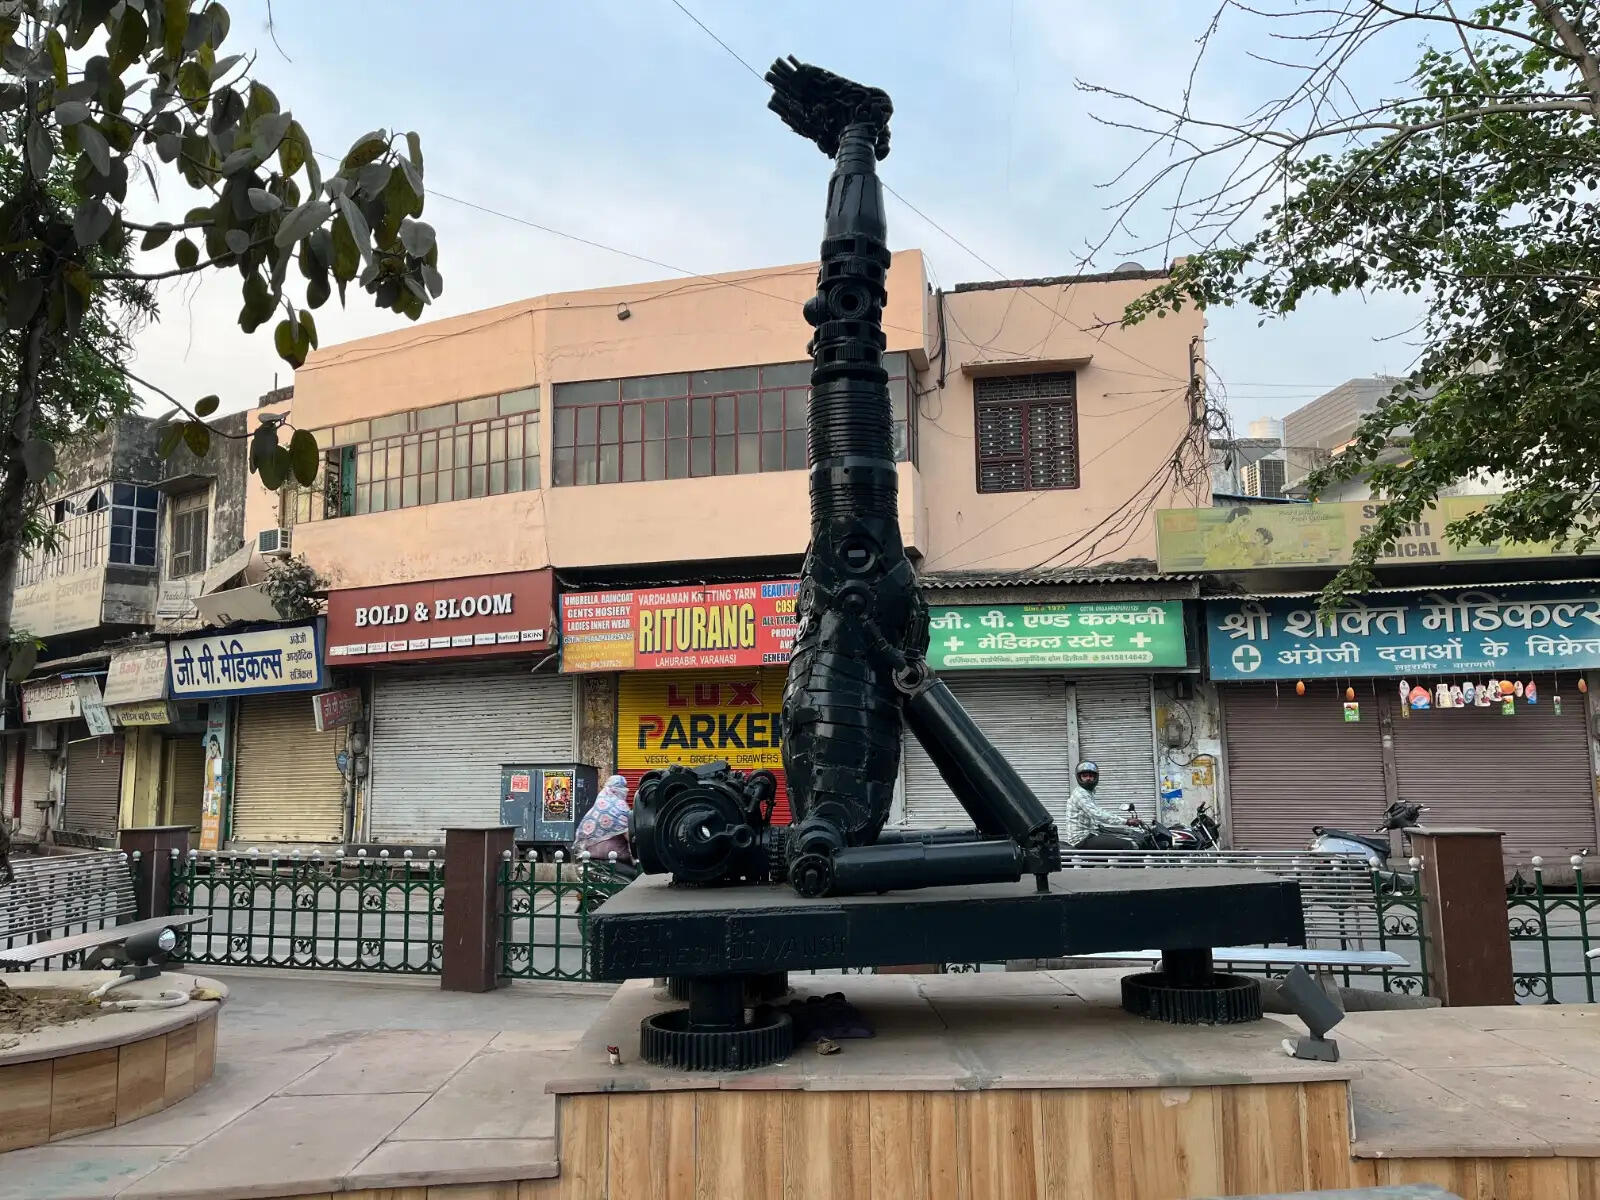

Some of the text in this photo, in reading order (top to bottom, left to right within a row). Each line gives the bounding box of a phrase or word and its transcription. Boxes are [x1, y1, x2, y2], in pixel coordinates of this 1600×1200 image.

[601, 593, 633, 604] RAINCOAT
[638, 593, 689, 606] VARDHAMAN
[733, 588, 756, 601] YARN
[762, 584, 791, 598] BEAUTY
[356, 593, 513, 627] BOLD & BLOOM
[567, 606, 631, 618] GENTS HOSIERY
[978, 610, 1014, 629] पी.
[1022, 613, 1072, 629] एण्ड
[1078, 606, 1166, 626] कम्पनी
[567, 621, 590, 632] LADIES
[611, 619, 630, 630] WEAR
[640, 603, 756, 654] RITURANG
[762, 616, 798, 627] ALL TYPES
[1217, 600, 1272, 641] श्री
[977, 631, 1115, 650] मेडिकल स्टोर
[700, 654, 736, 665] VARANASI
[1277, 641, 1361, 666] अंग्रेजी
[1375, 637, 1463, 662] दवाओं
[1480, 637, 1509, 658] के
[667, 680, 762, 708] LUX
[645, 754, 779, 765] VESTS BRIEFS DRAWERS
